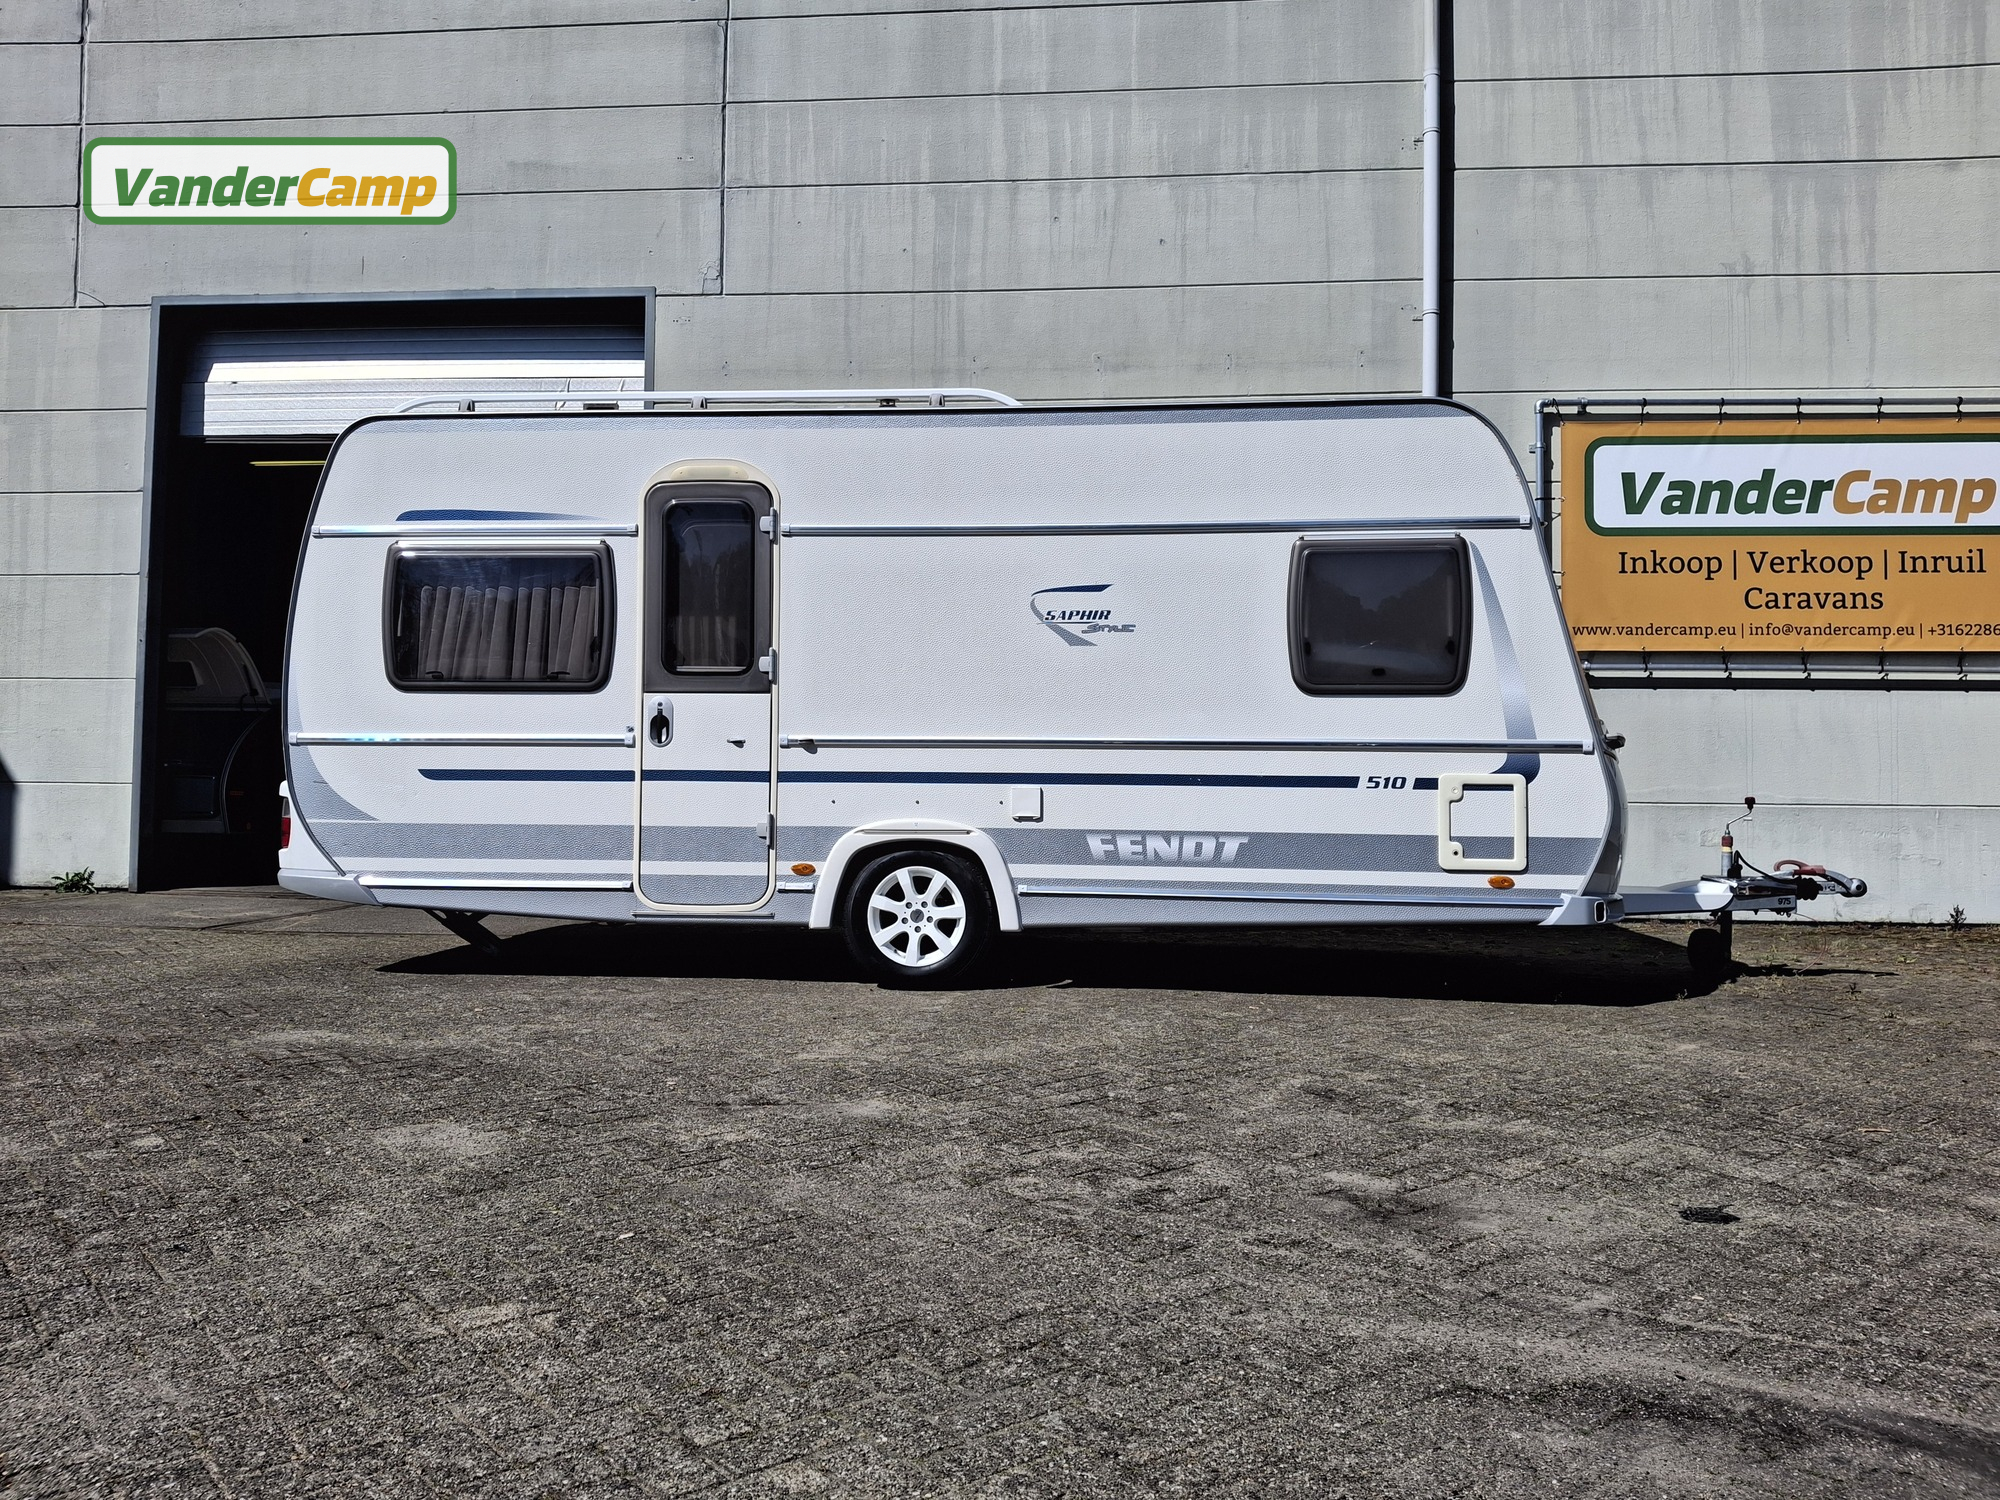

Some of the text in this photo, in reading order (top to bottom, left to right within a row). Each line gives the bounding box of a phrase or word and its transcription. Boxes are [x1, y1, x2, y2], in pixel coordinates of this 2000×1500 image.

[1620, 468, 1998, 524] VanderCamp
[1618, 550, 1723, 580] Inkoop
[1747, 550, 1874, 580] Verkoop
[1898, 548, 1987, 574] Inruil
[1743, 586, 1884, 610] Caravans
[1044, 610, 1111, 621] SAPHIR
[1572, 623, 1737, 639] www.vandercamp.eu
[1749, 622, 1915, 639] info@vandercamp.eu
[1366, 776, 1407, 789] 510
[1086, 834, 1249, 862] FENDT
